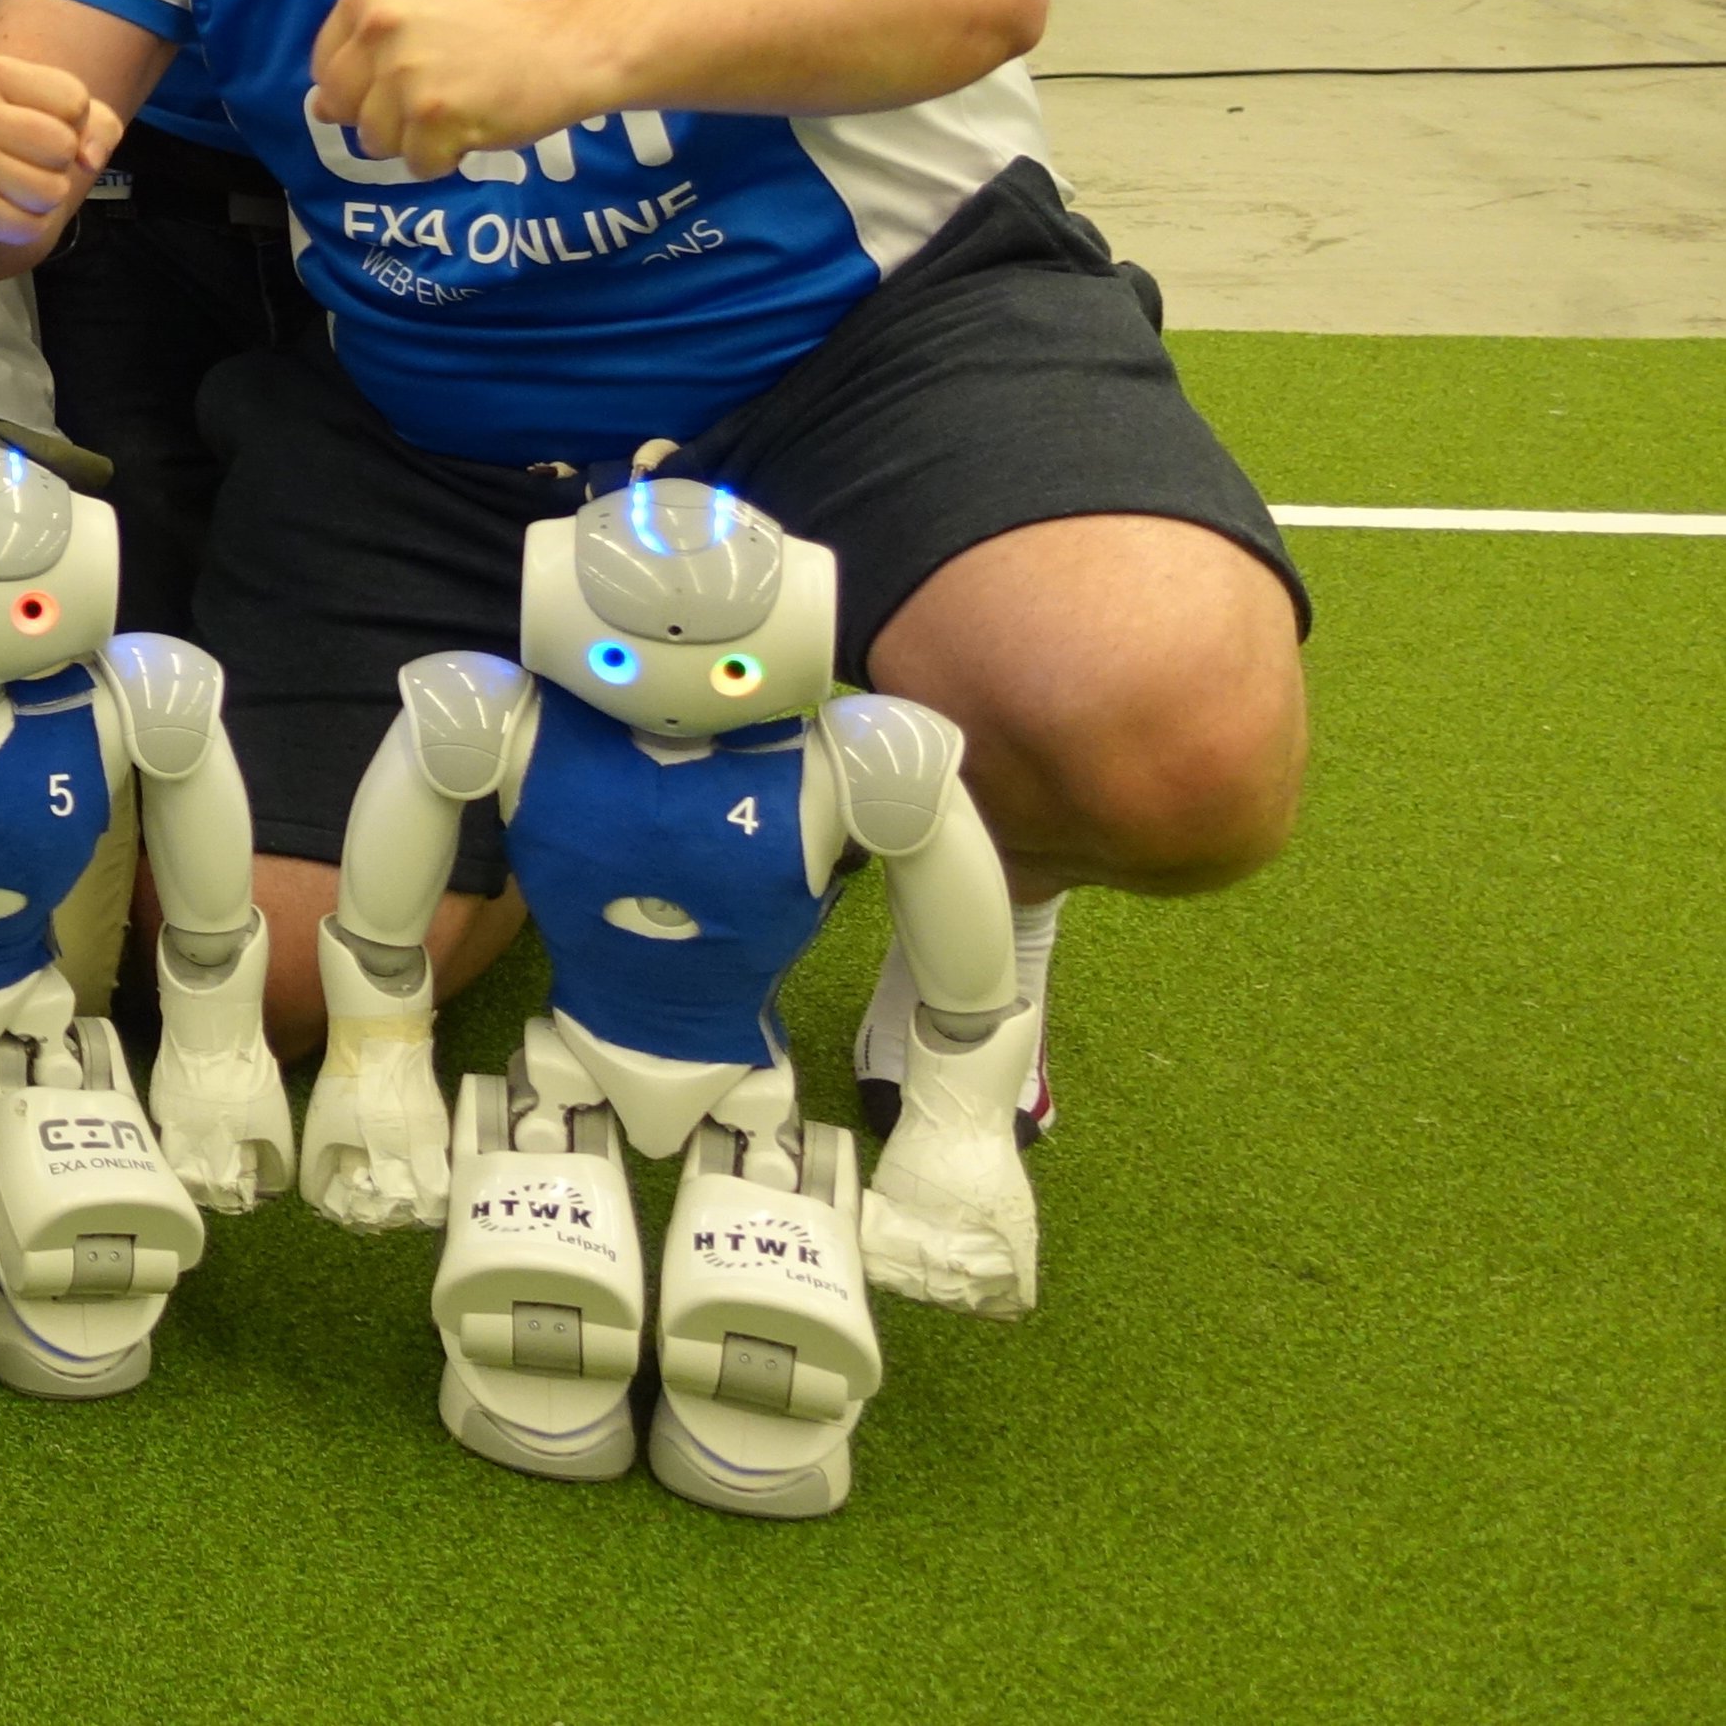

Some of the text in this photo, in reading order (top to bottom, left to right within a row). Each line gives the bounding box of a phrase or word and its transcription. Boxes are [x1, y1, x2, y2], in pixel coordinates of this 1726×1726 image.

[467, 180, 699, 268] ONLINE
[48, 773, 75, 817] 5
[727, 796, 760, 836] 4
[49, 1155, 156, 1175] EXA ONLINE
[470, 1197, 595, 1229] HTWK
[556, 1230, 616, 1262] Leipzig
[693, 1231, 823, 1268] HTWK
[786, 1268, 849, 1300] Leipzig
